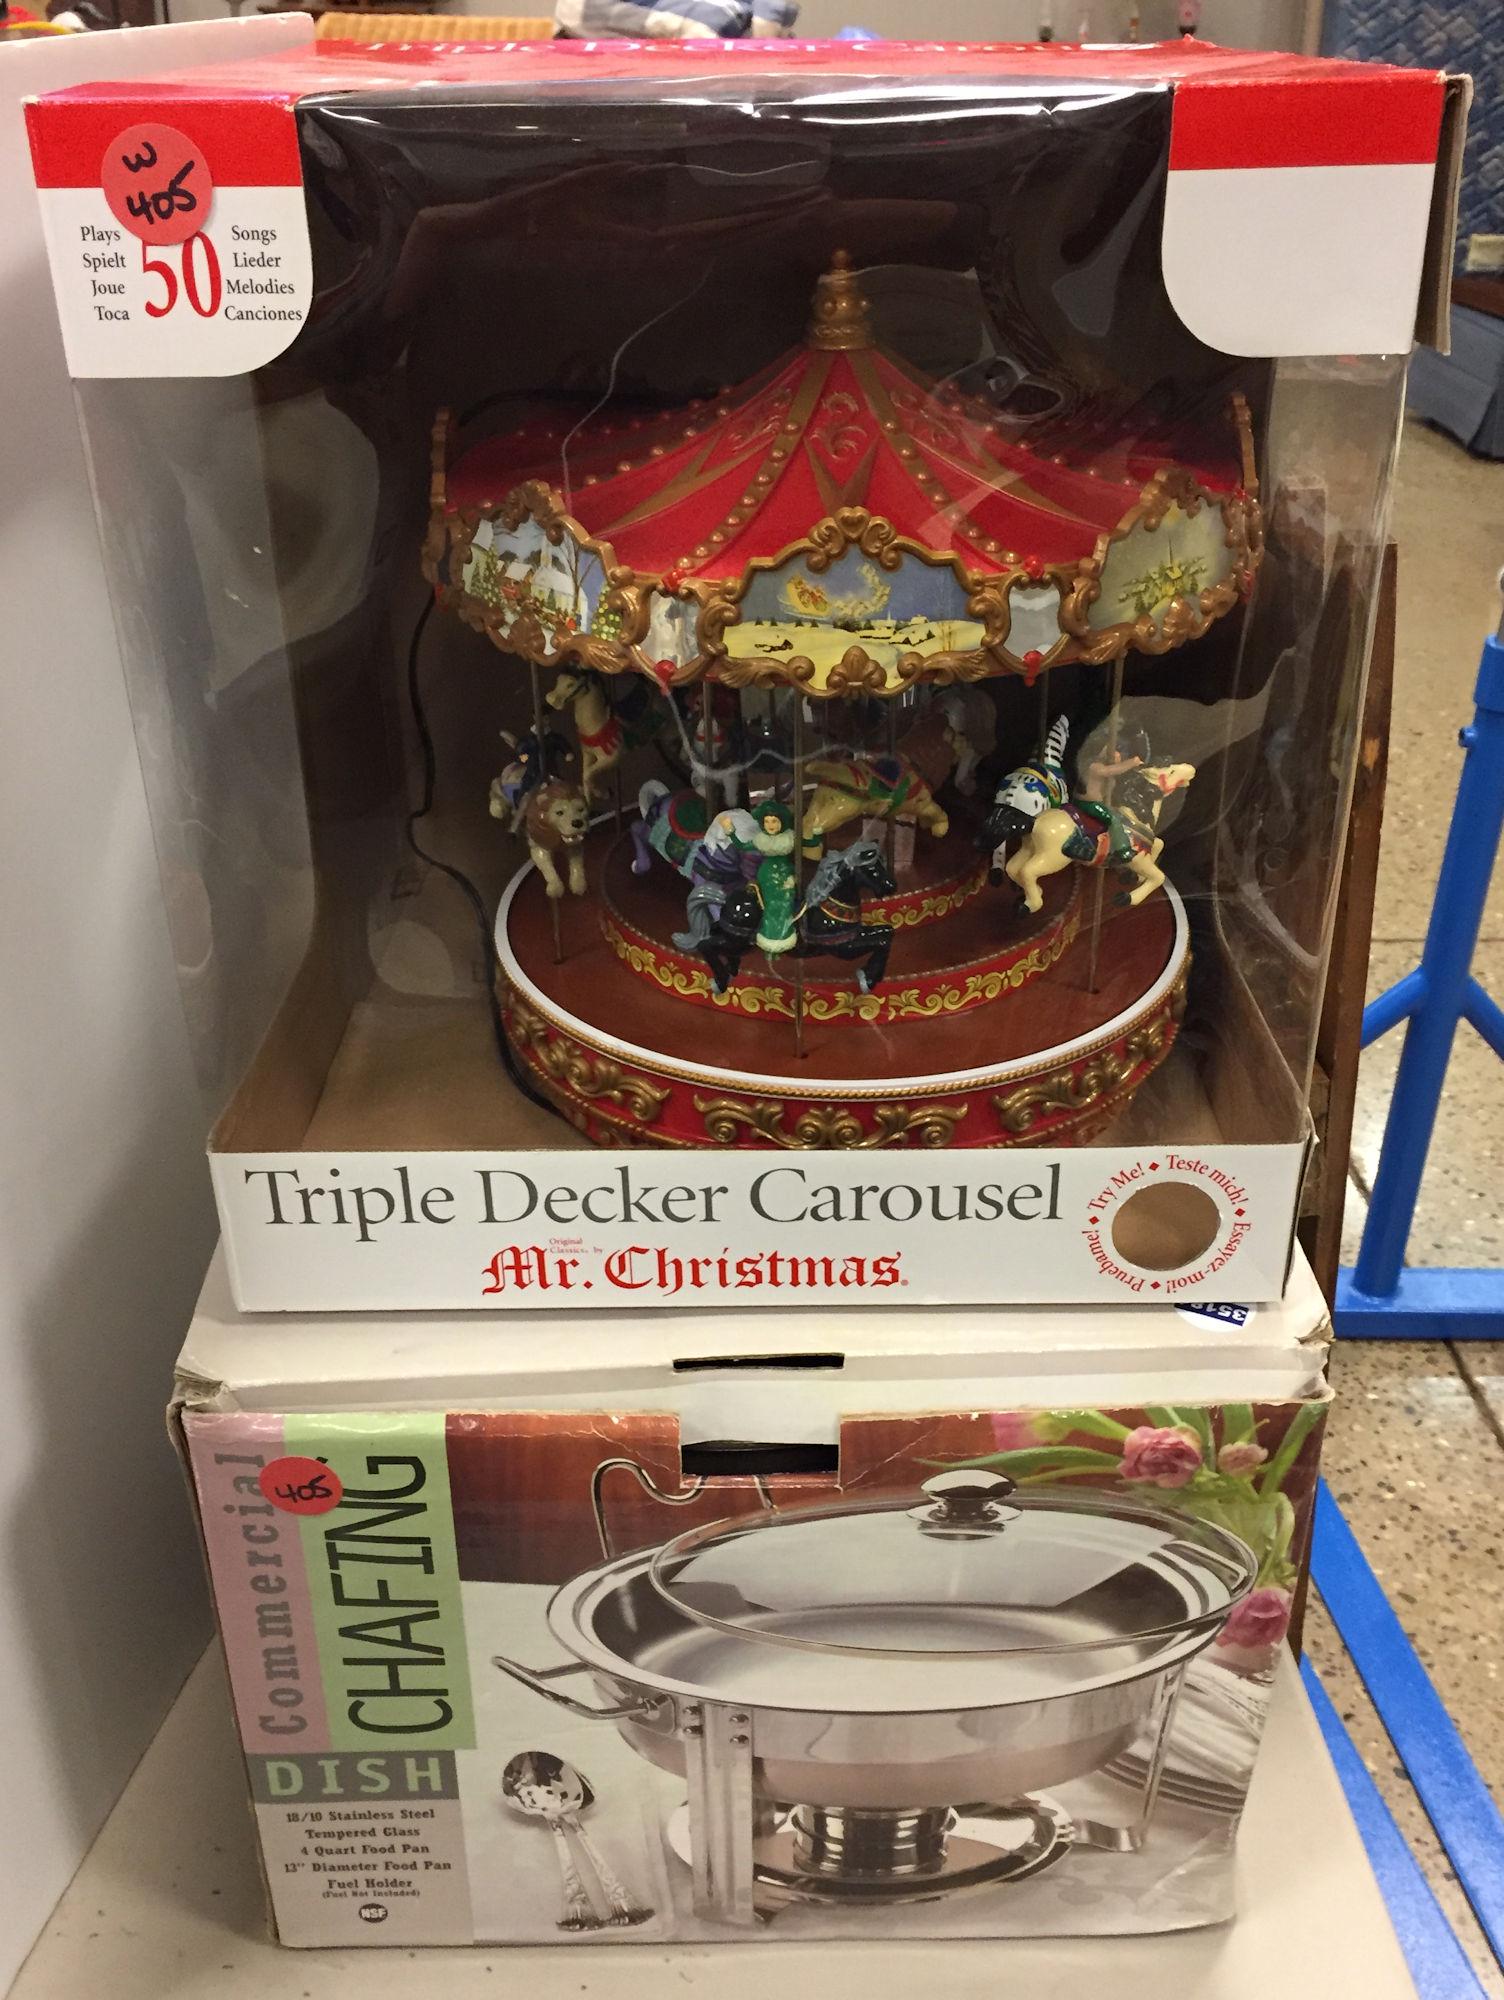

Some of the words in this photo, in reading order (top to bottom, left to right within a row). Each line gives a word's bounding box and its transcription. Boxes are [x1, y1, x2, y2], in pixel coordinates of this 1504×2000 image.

[80, 226, 121, 246] Plays
[231, 226, 278, 246] Songs
[82, 253, 127, 273] Spielt
[233, 252, 282, 268] Lieder
[142, 231, 222, 318] 50
[91, 280, 126, 297] Joue
[226, 279, 296, 295] Melodies
[93, 306, 130, 321] Toca
[224, 306, 303, 321] Canciones
[1087, 1188, 1118, 1211] Try
[1110, 1162, 1145, 1190] Me!
[1166, 1154, 1209, 1175] Teste
[1208, 1168, 1249, 1206] mich!
[244, 1166, 456, 1242] Triple
[474, 1166, 729, 1224] Decker
[750, 1163, 1064, 1223] Carousel
[549, 1237, 583, 1246] Original
[1166, 1222, 1251, 1294] Essayez-moi!
[481, 1245, 594, 1296] Mr.
[213, 1451, 309, 1736] Commercial
[316, 1455, 453, 1735] CHAFING
[265, 1757, 443, 1796] DISH
[286, 1811, 323, 1823] 18/10
[329, 1810, 394, 1821] Stainless
[400, 1809, 435, 1819] Steel
[305, 1828, 376, 1840] Tempered
[383, 1826, 420, 1837] Glass
[301, 1846, 308, 1856] 4
[315, 1845, 356, 1856] Quart
[361, 1845, 396, 1855] Food
[402, 1844, 430, 1854] Pan
[312, 1863, 377, 1873] Diameter
[384, 1862, 417, 1872] Food
[424, 1861, 452, 1871] Pan
[328, 1879, 359, 1889] Fuel
[364, 1878, 413, 1889] Holder
[361, 1908, 386, 1918] NSF
